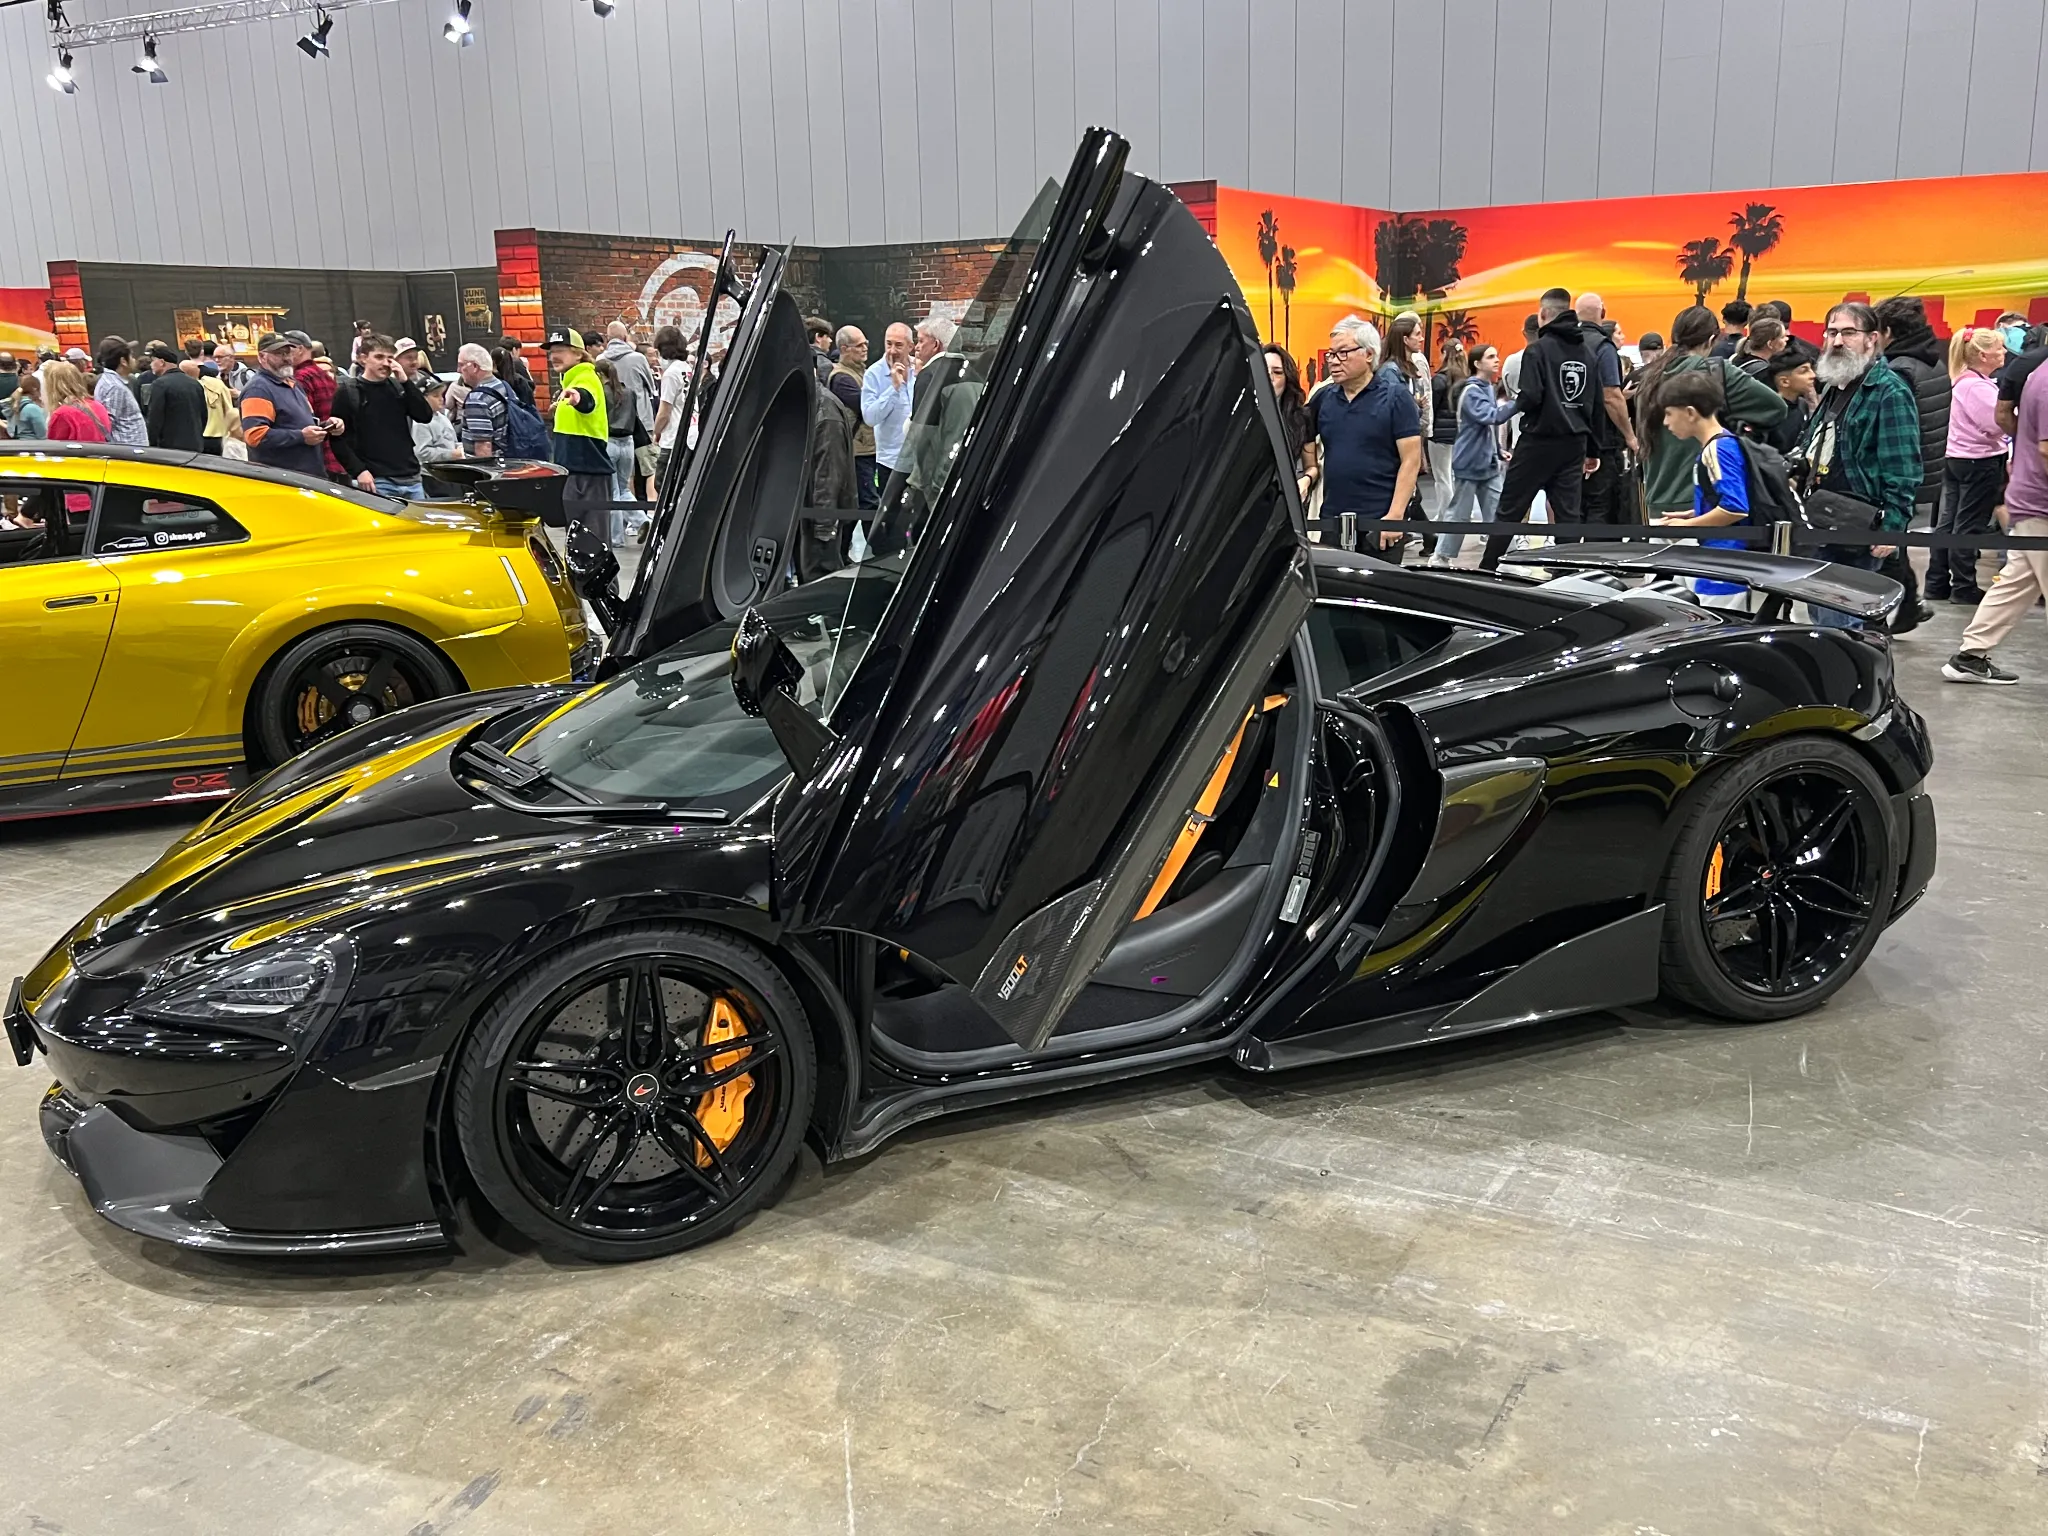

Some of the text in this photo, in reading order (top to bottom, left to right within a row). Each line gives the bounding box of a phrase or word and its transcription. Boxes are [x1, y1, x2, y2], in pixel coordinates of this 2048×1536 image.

[464, 289, 485, 297] JUNK
[464, 298, 486, 306] YARD
[1000, 955, 1028, 1001] 600LT
